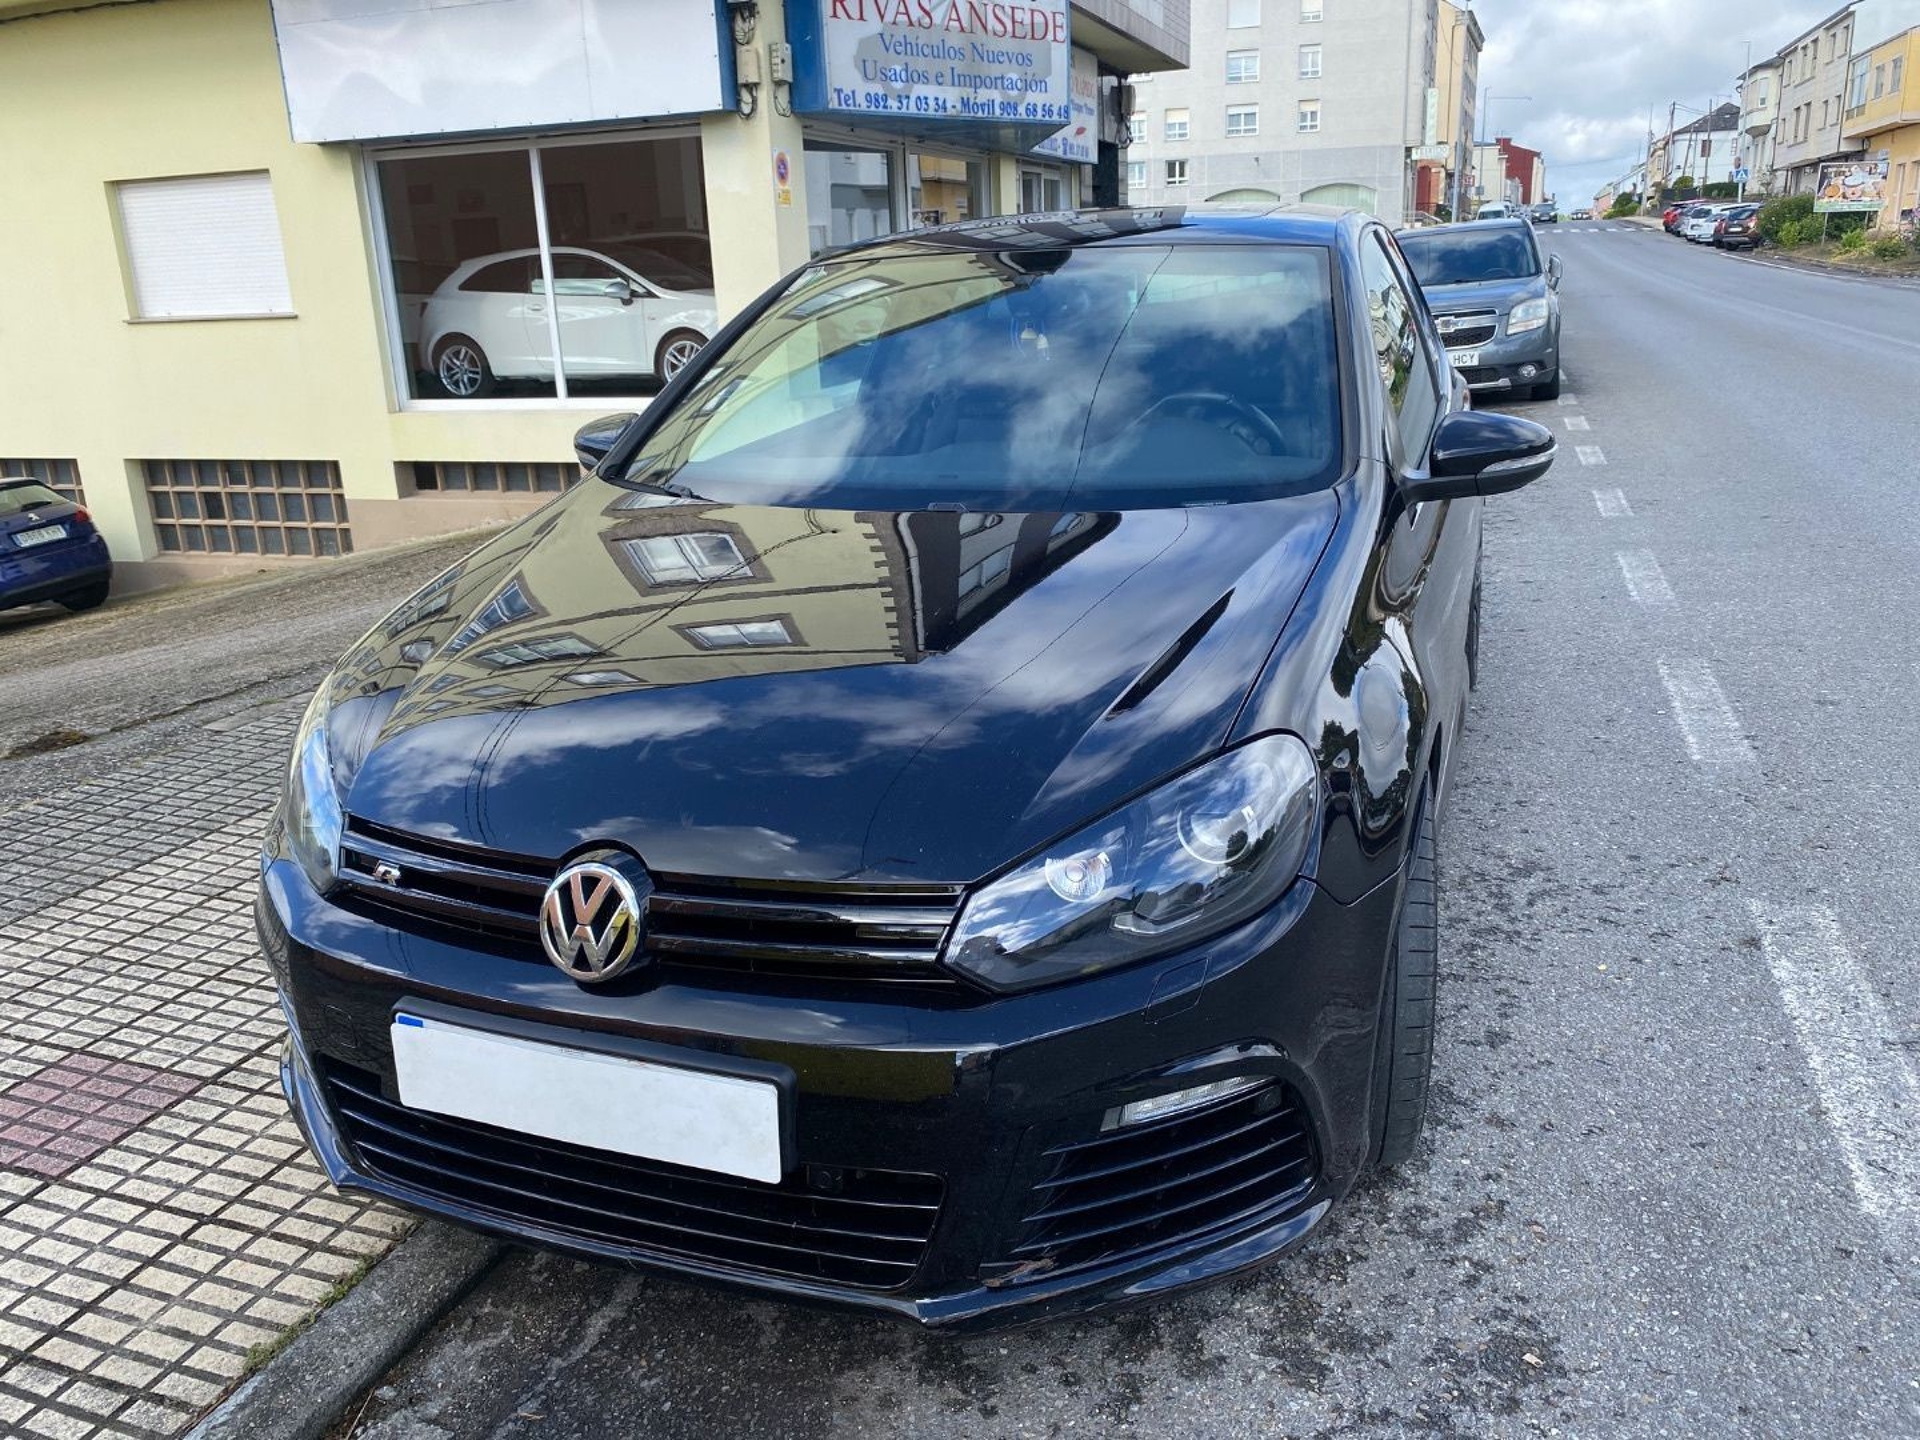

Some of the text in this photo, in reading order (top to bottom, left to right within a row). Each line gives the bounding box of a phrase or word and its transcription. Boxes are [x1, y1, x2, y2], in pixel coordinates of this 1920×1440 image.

[829, 0, 1066, 43] RIVAS ANSEDE
[877, 32, 1033, 67] Vehículos Nuevos
[861, 58, 930, 85] Usados
[935, 70, 944, 86] e
[949, 66, 1048, 94] Importación
[833, 87, 861, 108] Tel.
[865, 92, 892, 110] 982.
[960, 96, 995, 116] Móvil
[1452, 353, 1475, 365] HCY
